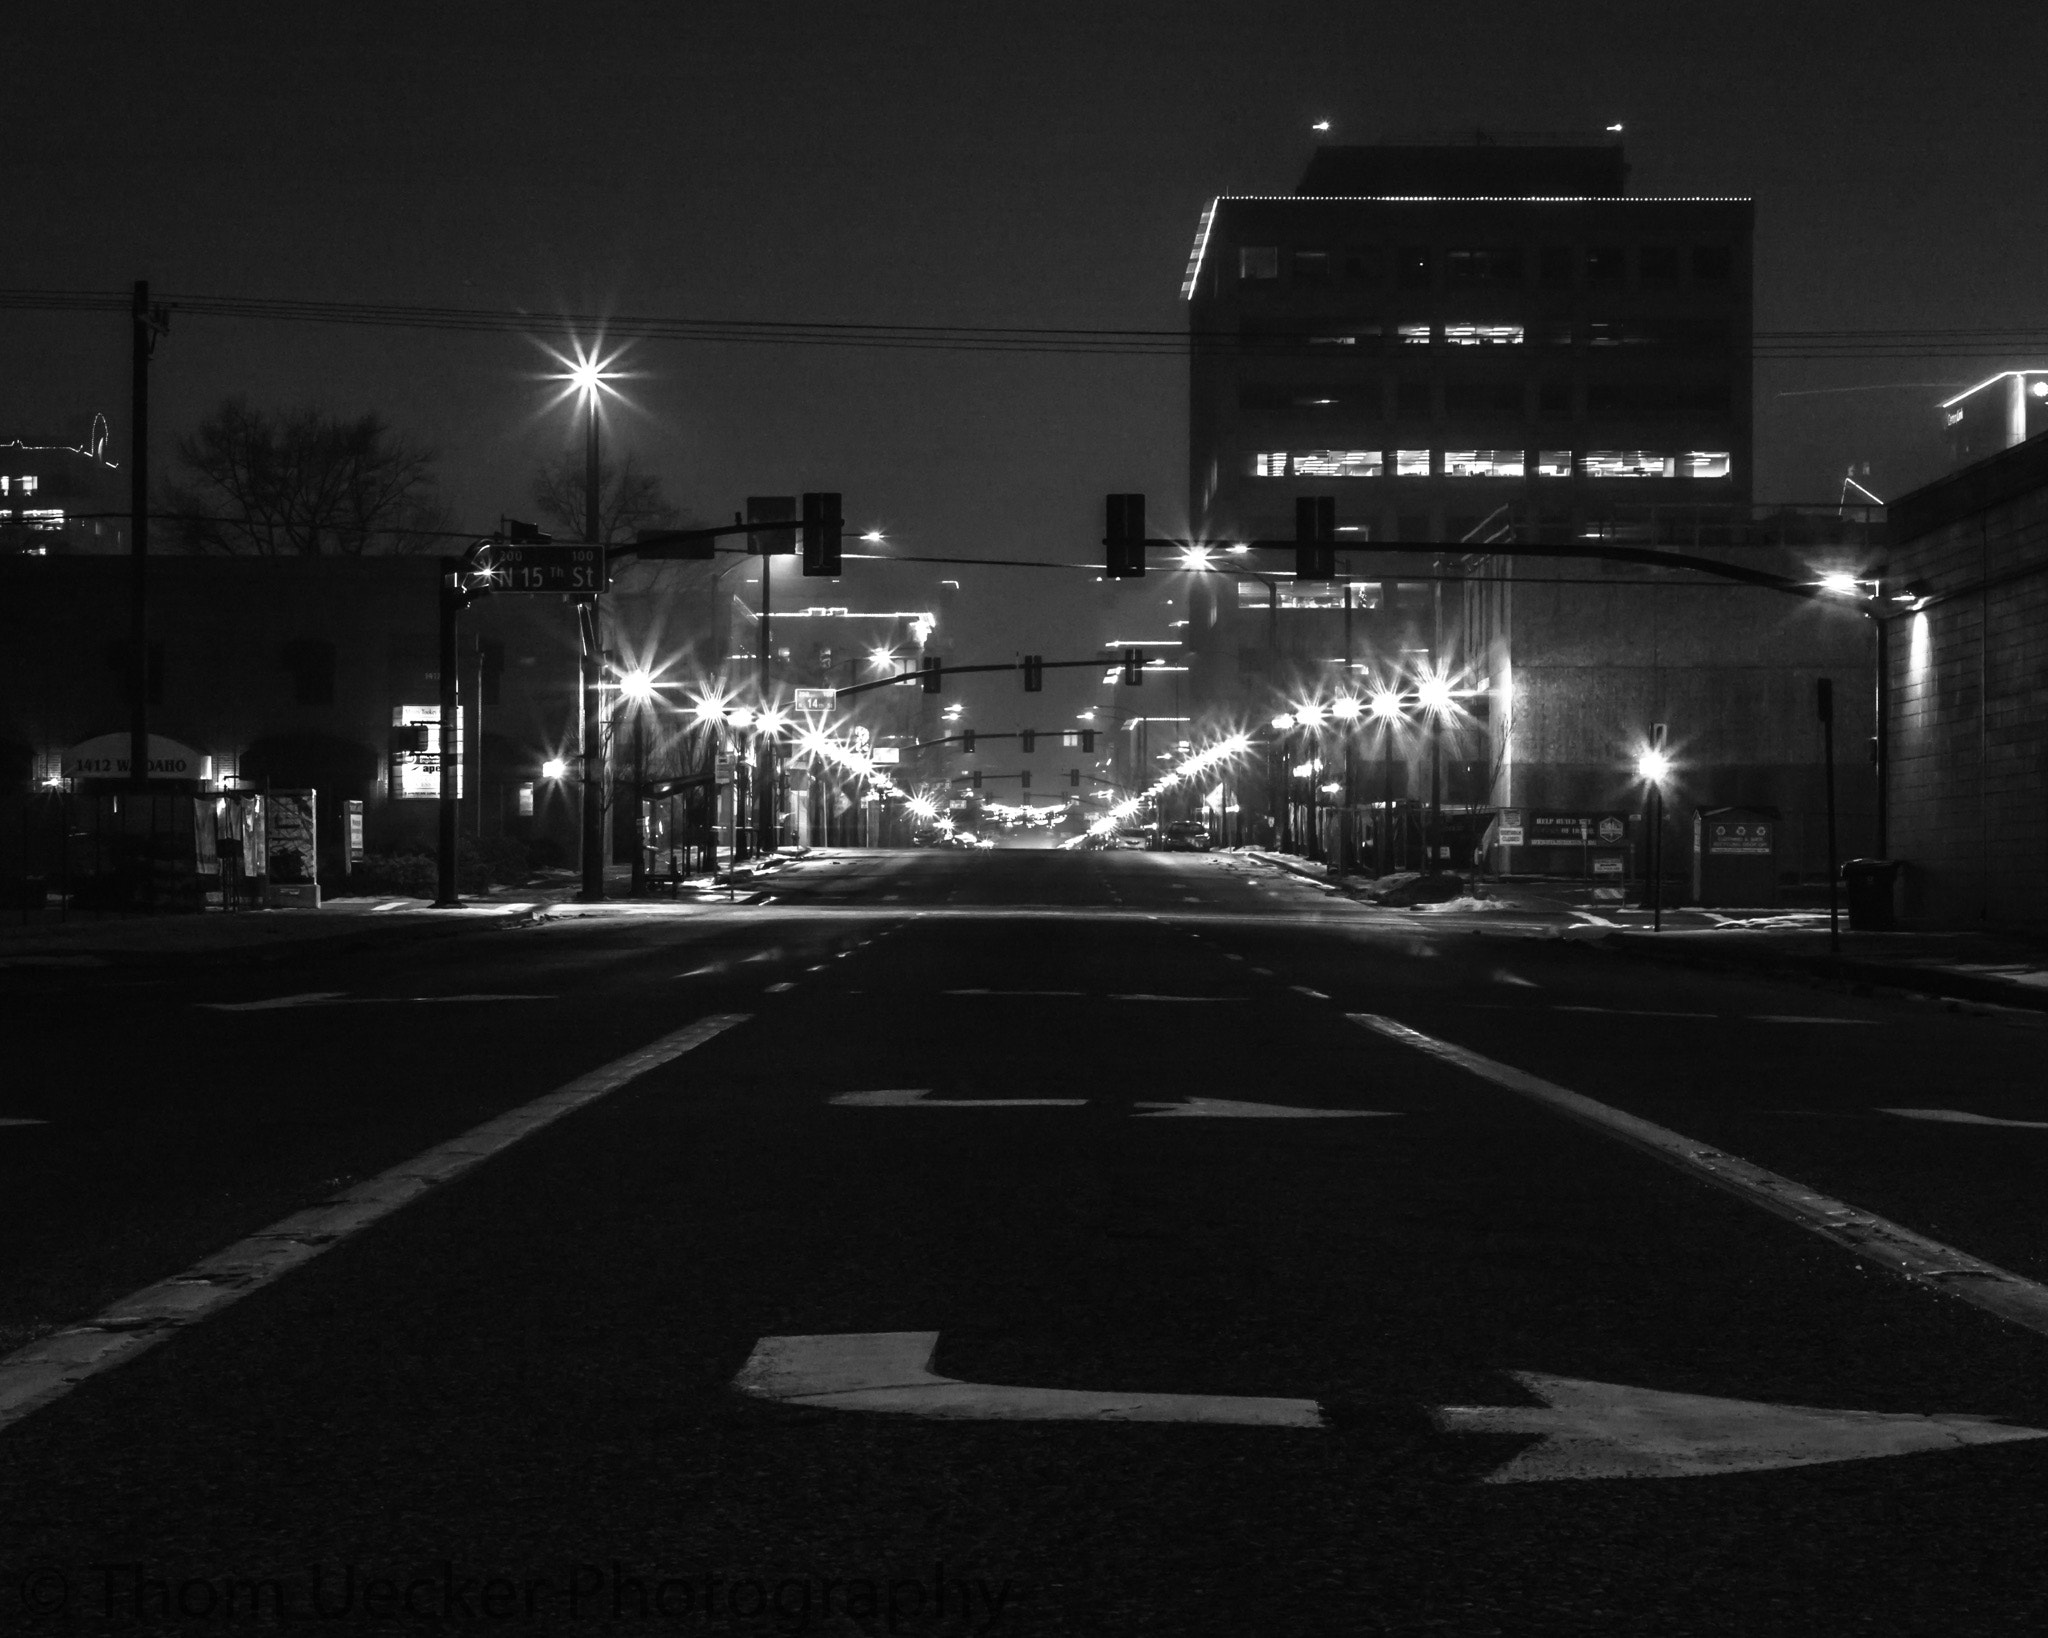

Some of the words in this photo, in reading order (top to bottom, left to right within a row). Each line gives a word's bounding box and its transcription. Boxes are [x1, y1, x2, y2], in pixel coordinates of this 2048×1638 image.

[500, 551, 522, 561] 200
[573, 551, 594, 561] 100
[500, 567, 513, 587] N
[573, 567, 593, 587] St
[77, 759, 112, 772] 1412
